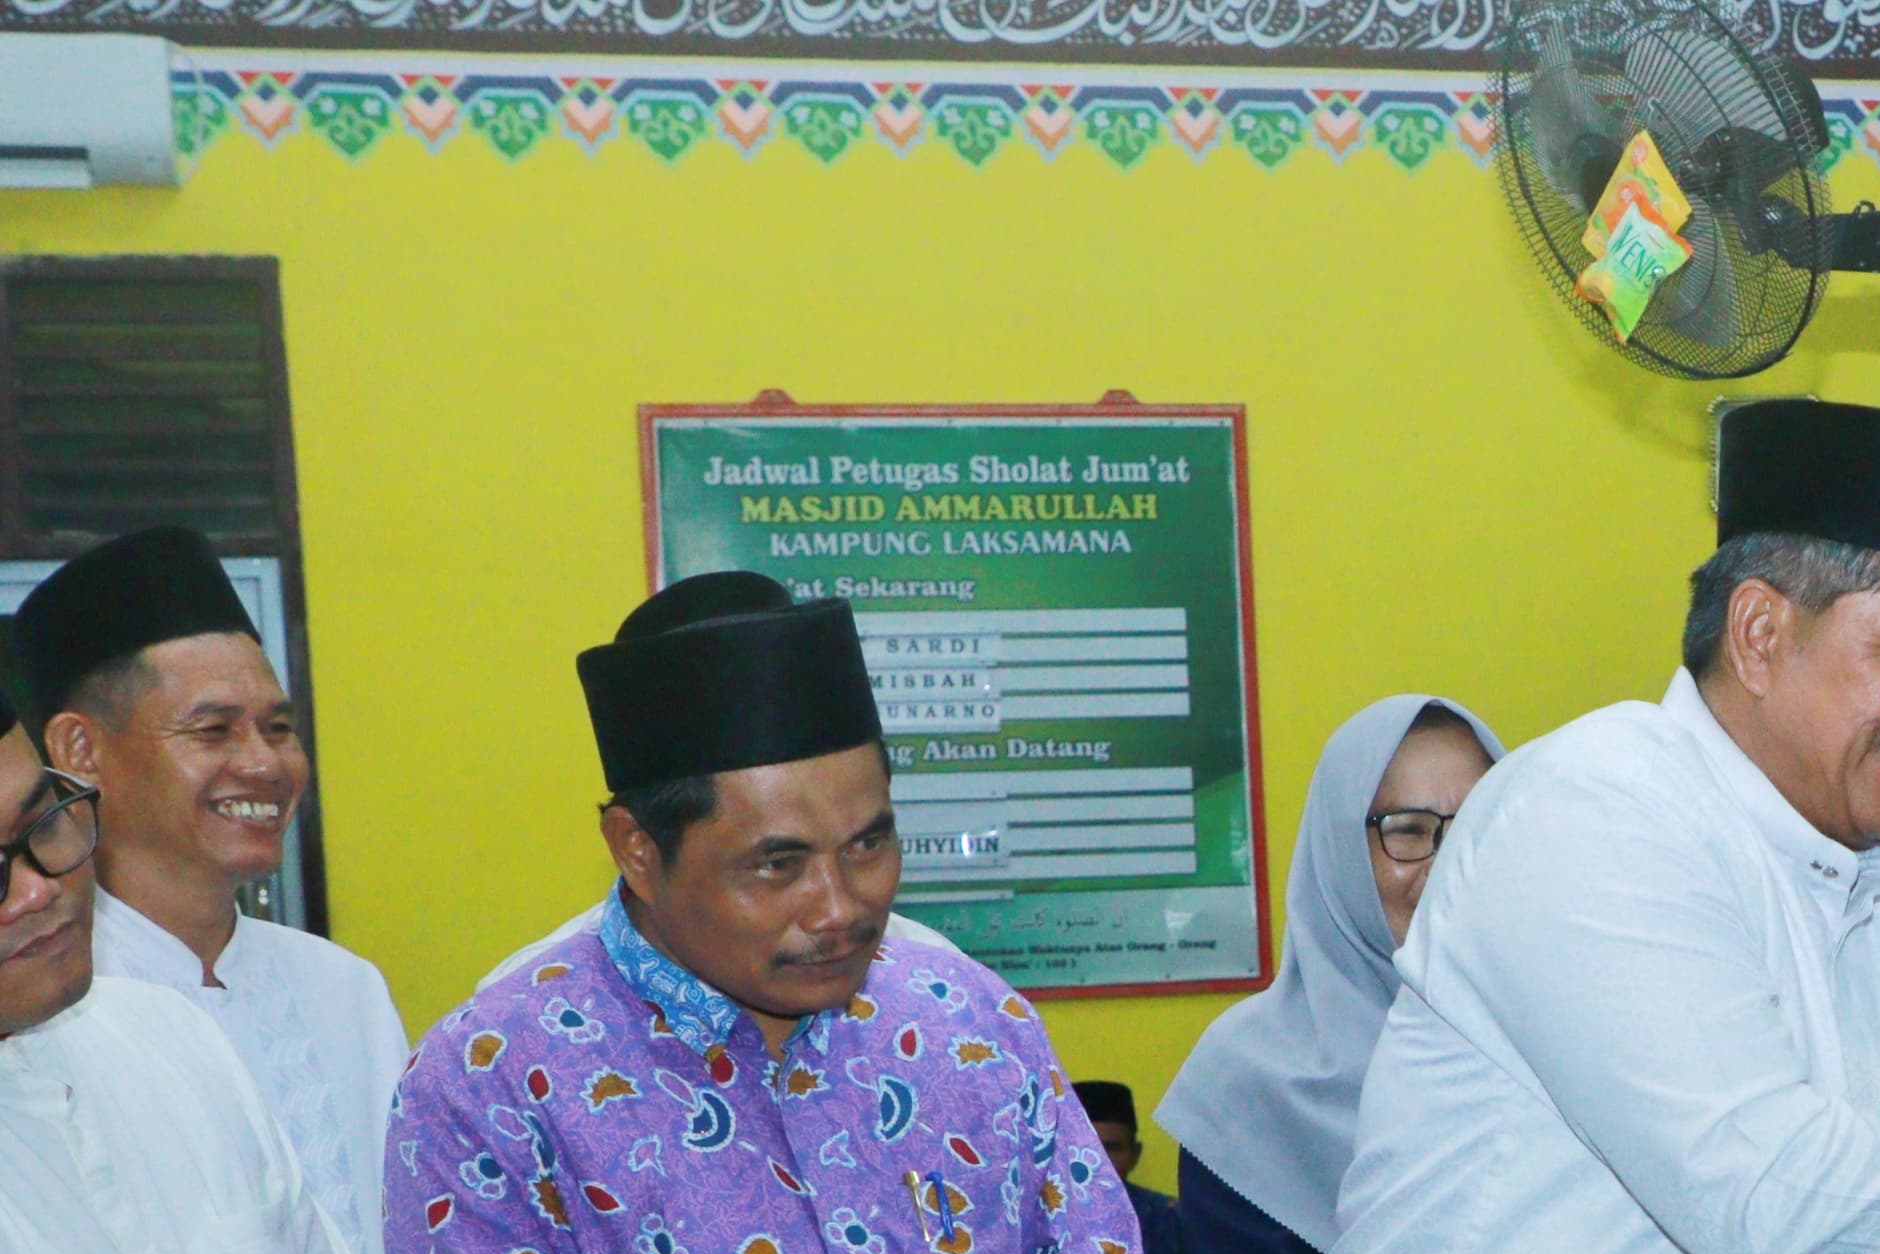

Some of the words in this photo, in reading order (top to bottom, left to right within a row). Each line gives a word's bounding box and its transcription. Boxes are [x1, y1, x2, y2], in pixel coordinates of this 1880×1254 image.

[703, 455, 822, 486] Jadwal
[829, 455, 960, 493] Petugas
[969, 454, 1074, 484] Sholat
[1081, 454, 1191, 483] Jum'at
[740, 495, 886, 523] MASJID
[895, 493, 1159, 522] AMMARULLAH
[769, 530, 933, 557] KAMPUNG
[942, 529, 1132, 555] LAKSAMANA
[834, 576, 976, 601] Sekarang
[887, 703, 996, 719] UNARNO
[923, 739, 998, 761] Akan
[1006, 737, 1112, 763] Datang
